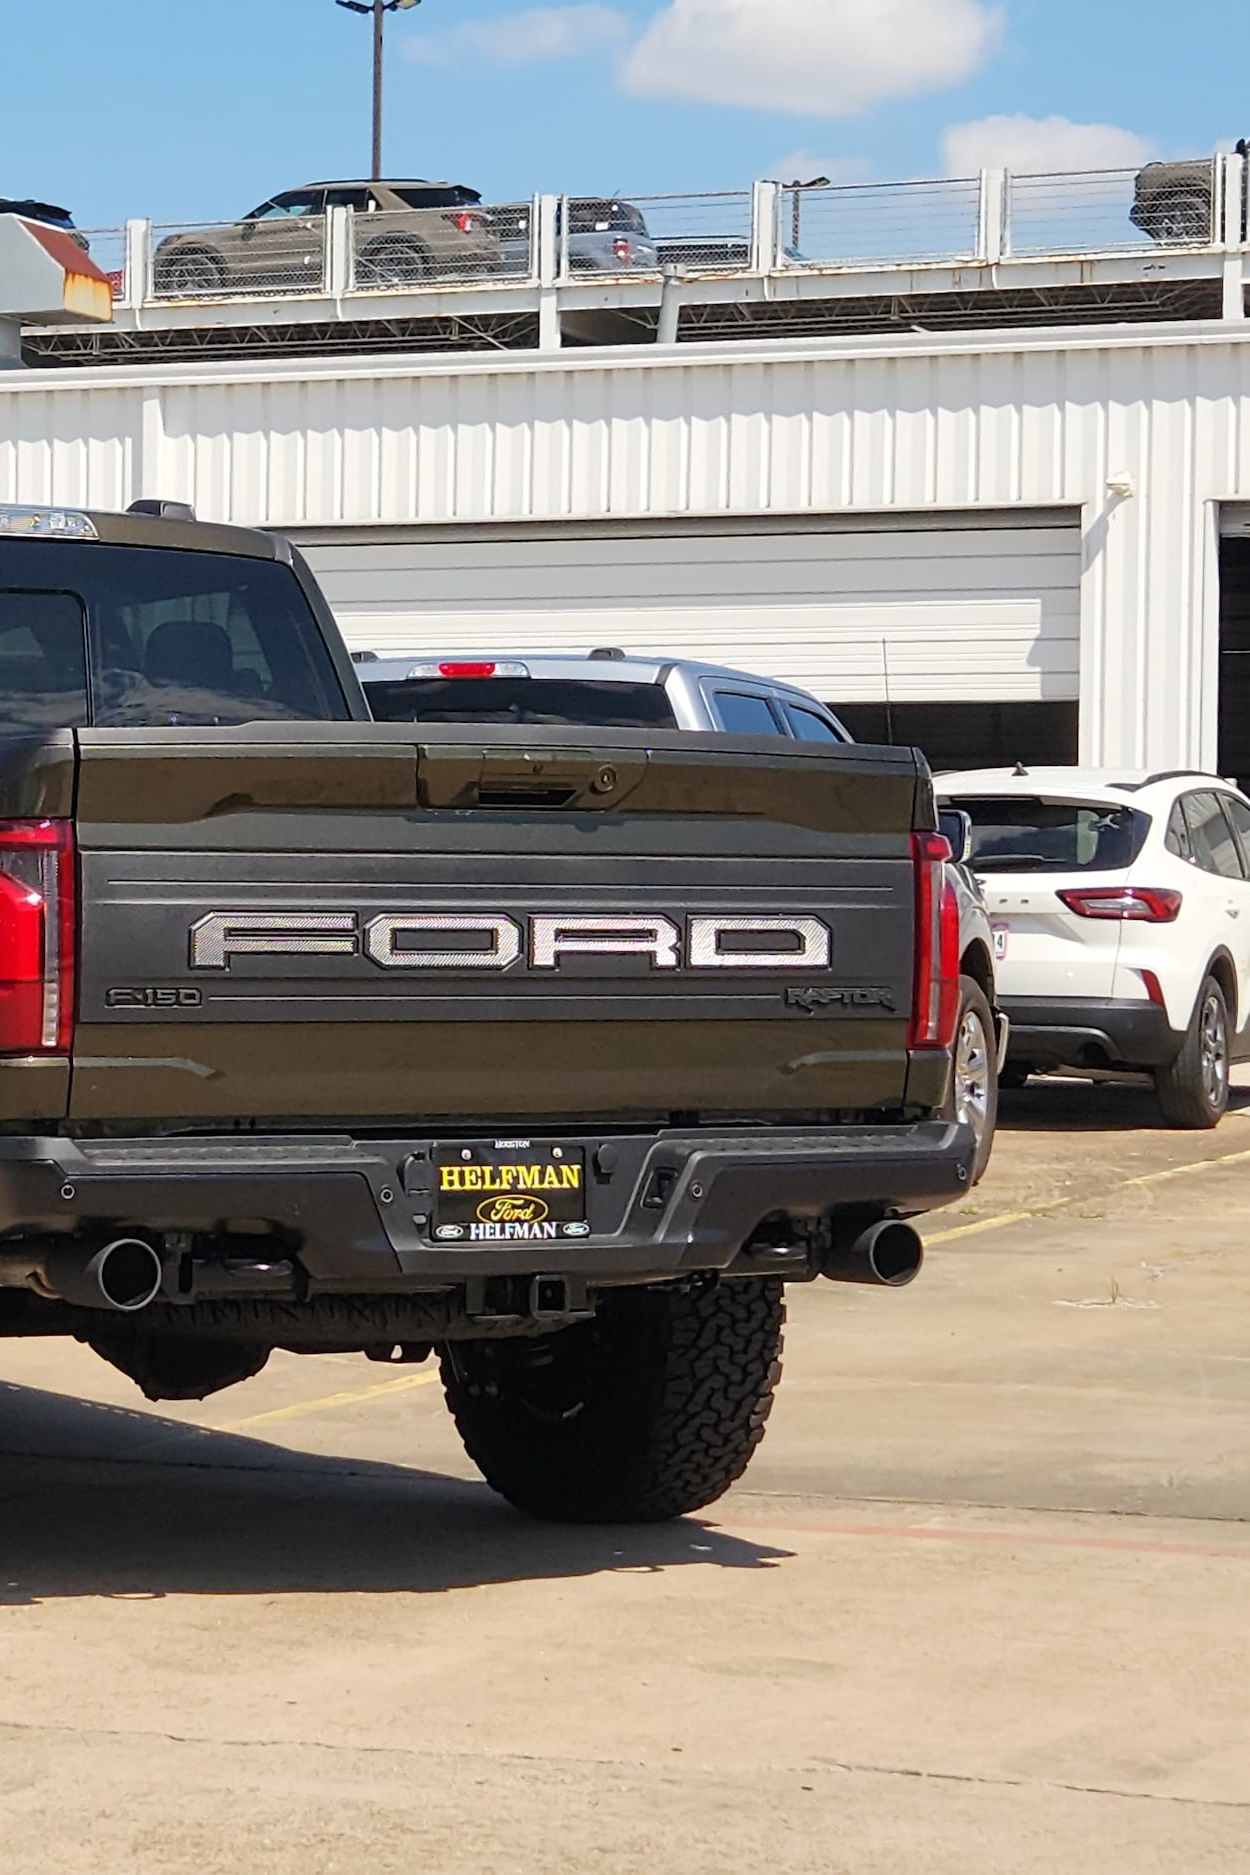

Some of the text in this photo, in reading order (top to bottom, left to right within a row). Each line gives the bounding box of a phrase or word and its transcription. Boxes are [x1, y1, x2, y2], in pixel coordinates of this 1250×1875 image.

[189, 910, 831, 970] FORD
[106, 988, 202, 1006] F-150
[785, 986, 897, 1015] RAPTOR
[439, 1164, 581, 1191] HELFMAN
[490, 1198, 536, 1221] Ford
[469, 1222, 556, 1240] HELFMAN
